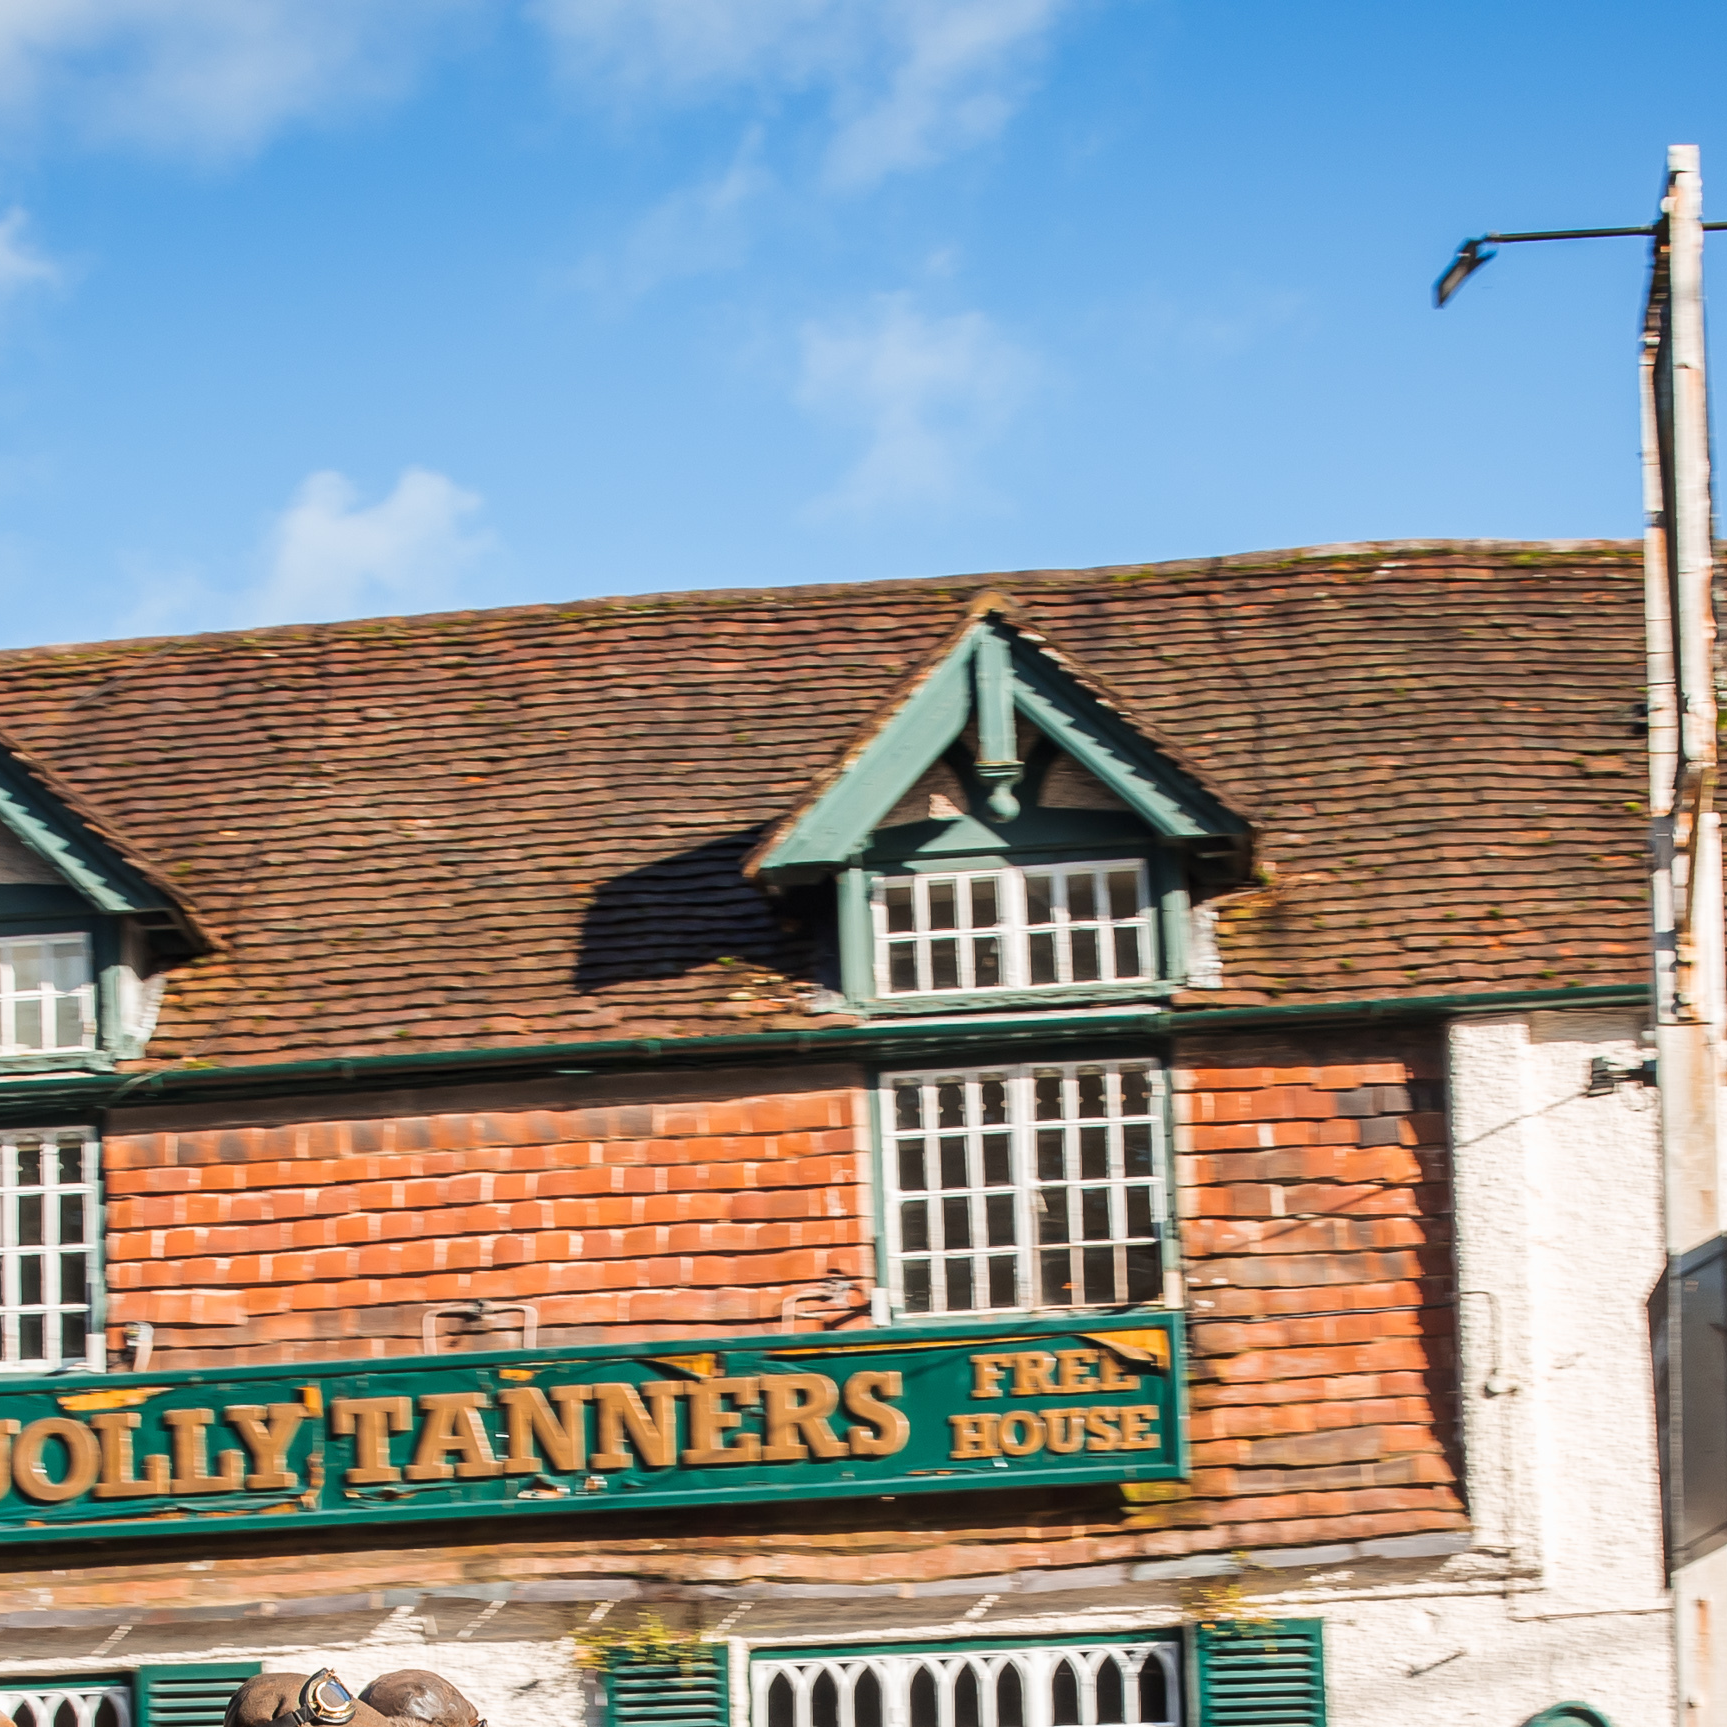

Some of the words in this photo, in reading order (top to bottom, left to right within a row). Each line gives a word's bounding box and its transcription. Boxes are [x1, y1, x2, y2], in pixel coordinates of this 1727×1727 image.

[970, 1348, 1142, 1398] FREE
[331, 1370, 911, 1486] TANNERS
[948, 1404, 1162, 1459] HOUSE
